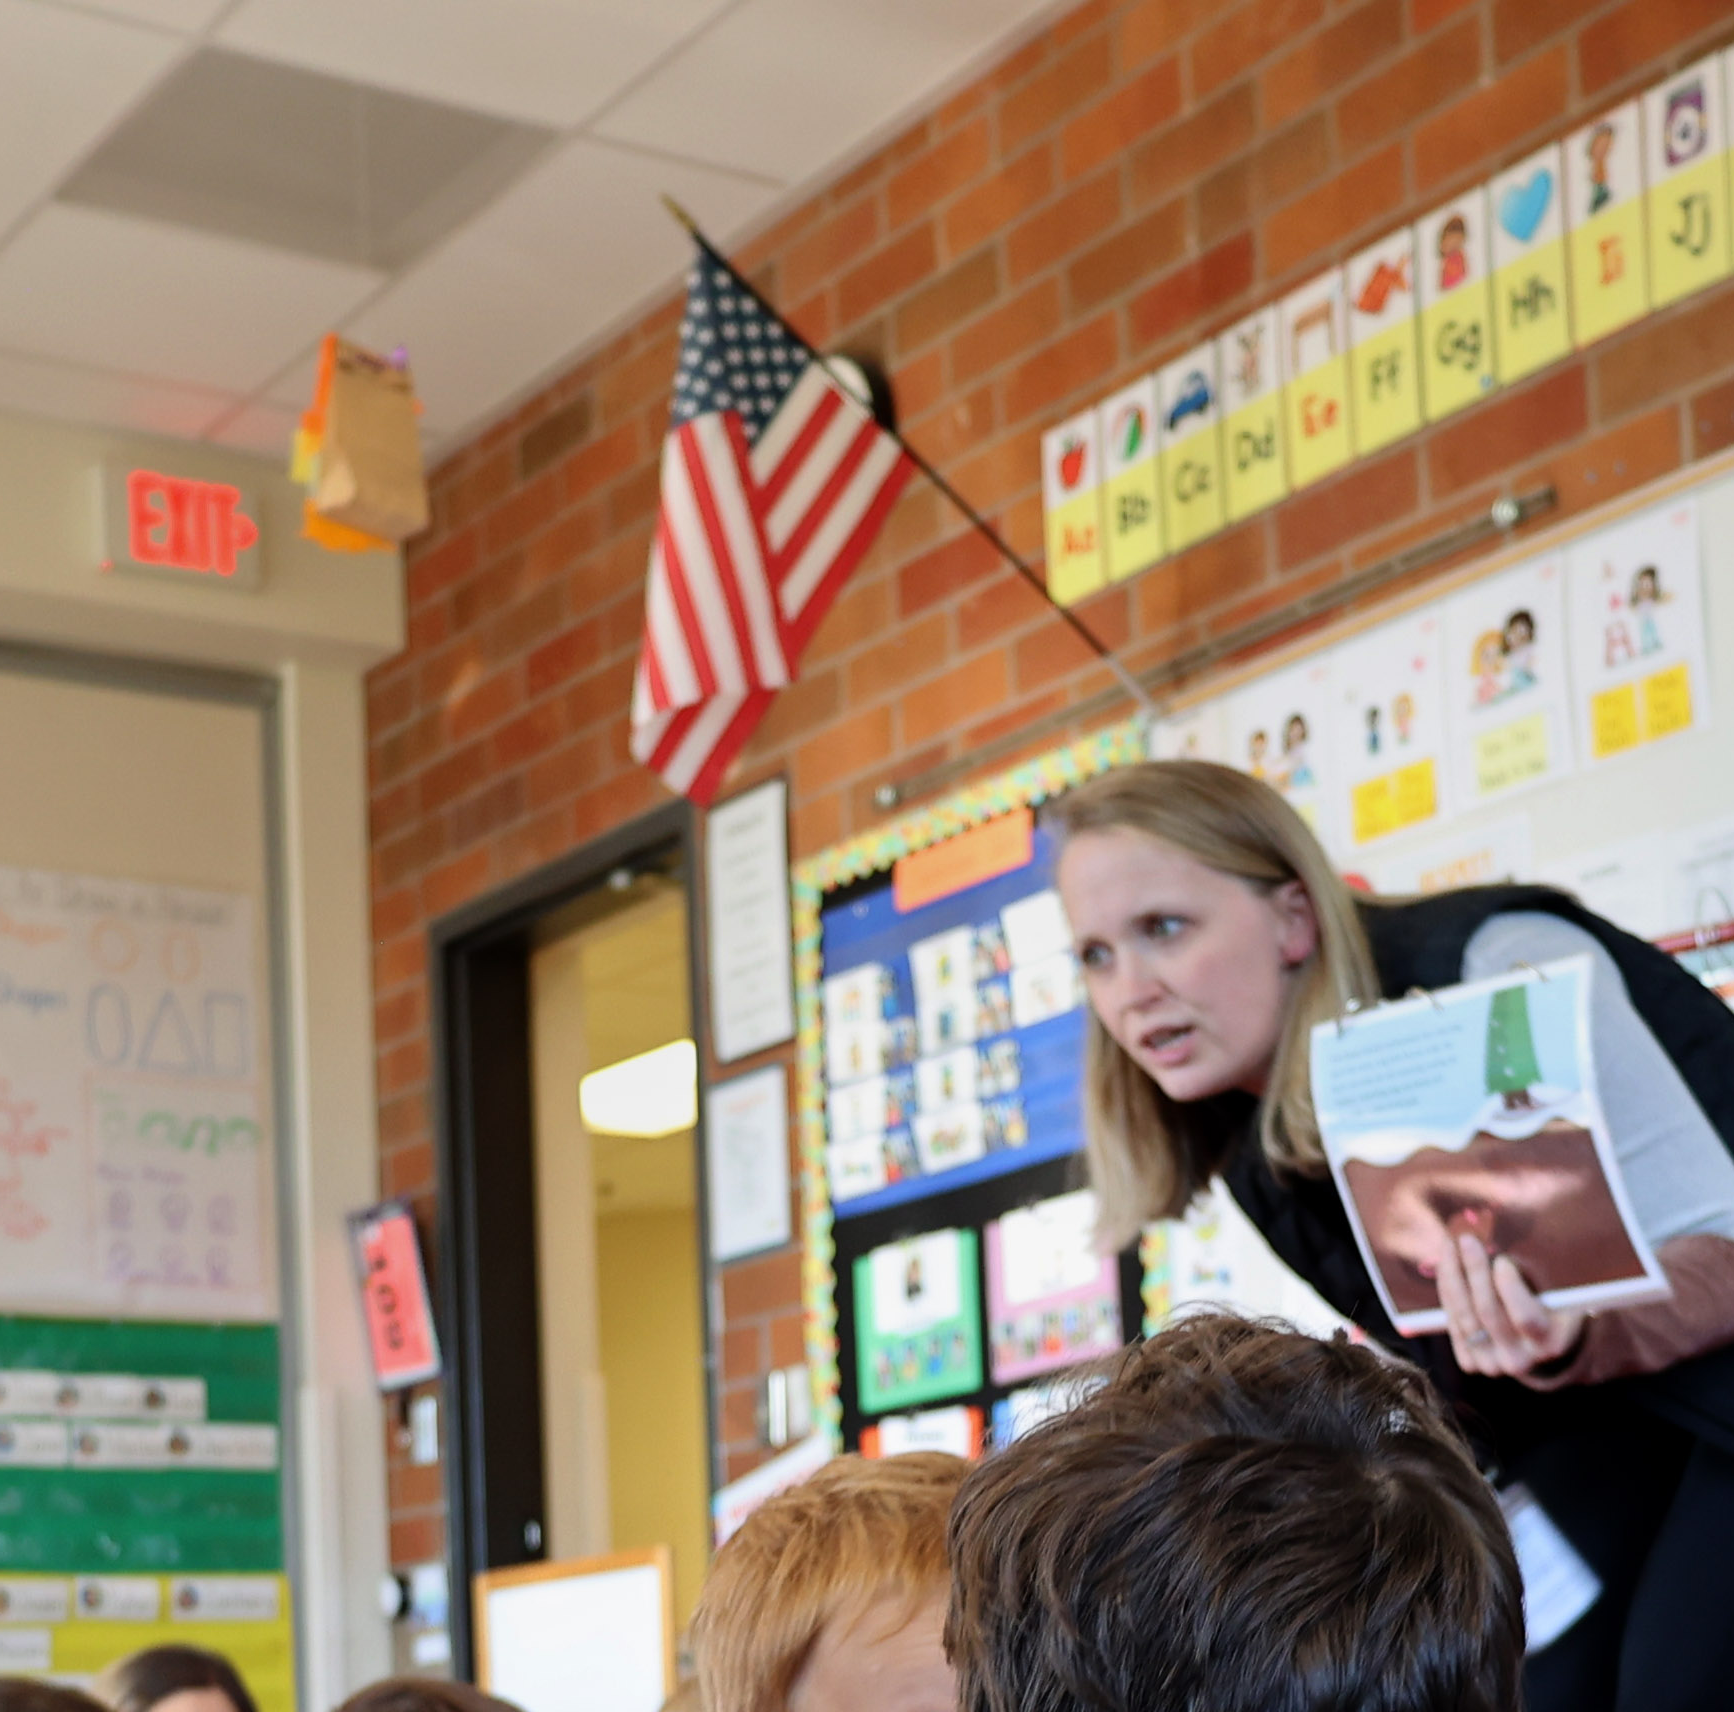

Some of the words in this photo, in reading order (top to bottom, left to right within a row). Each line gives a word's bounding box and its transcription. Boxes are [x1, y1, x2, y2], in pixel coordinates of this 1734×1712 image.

[1118, 495, 1151, 535] Bb
[1174, 459, 1212, 504] Cc
[1235, 420, 1277, 472] Dd
[1300, 393, 1341, 439] Ee
[1368, 349, 1403, 401] Ff
[1436, 317, 1484, 372] Gg
[1508, 274, 1556, 329] Hh
[1597, 234, 1626, 288] Ii
[1668, 191, 1713, 257] Jj
[126, 468, 242, 577] EXIT
